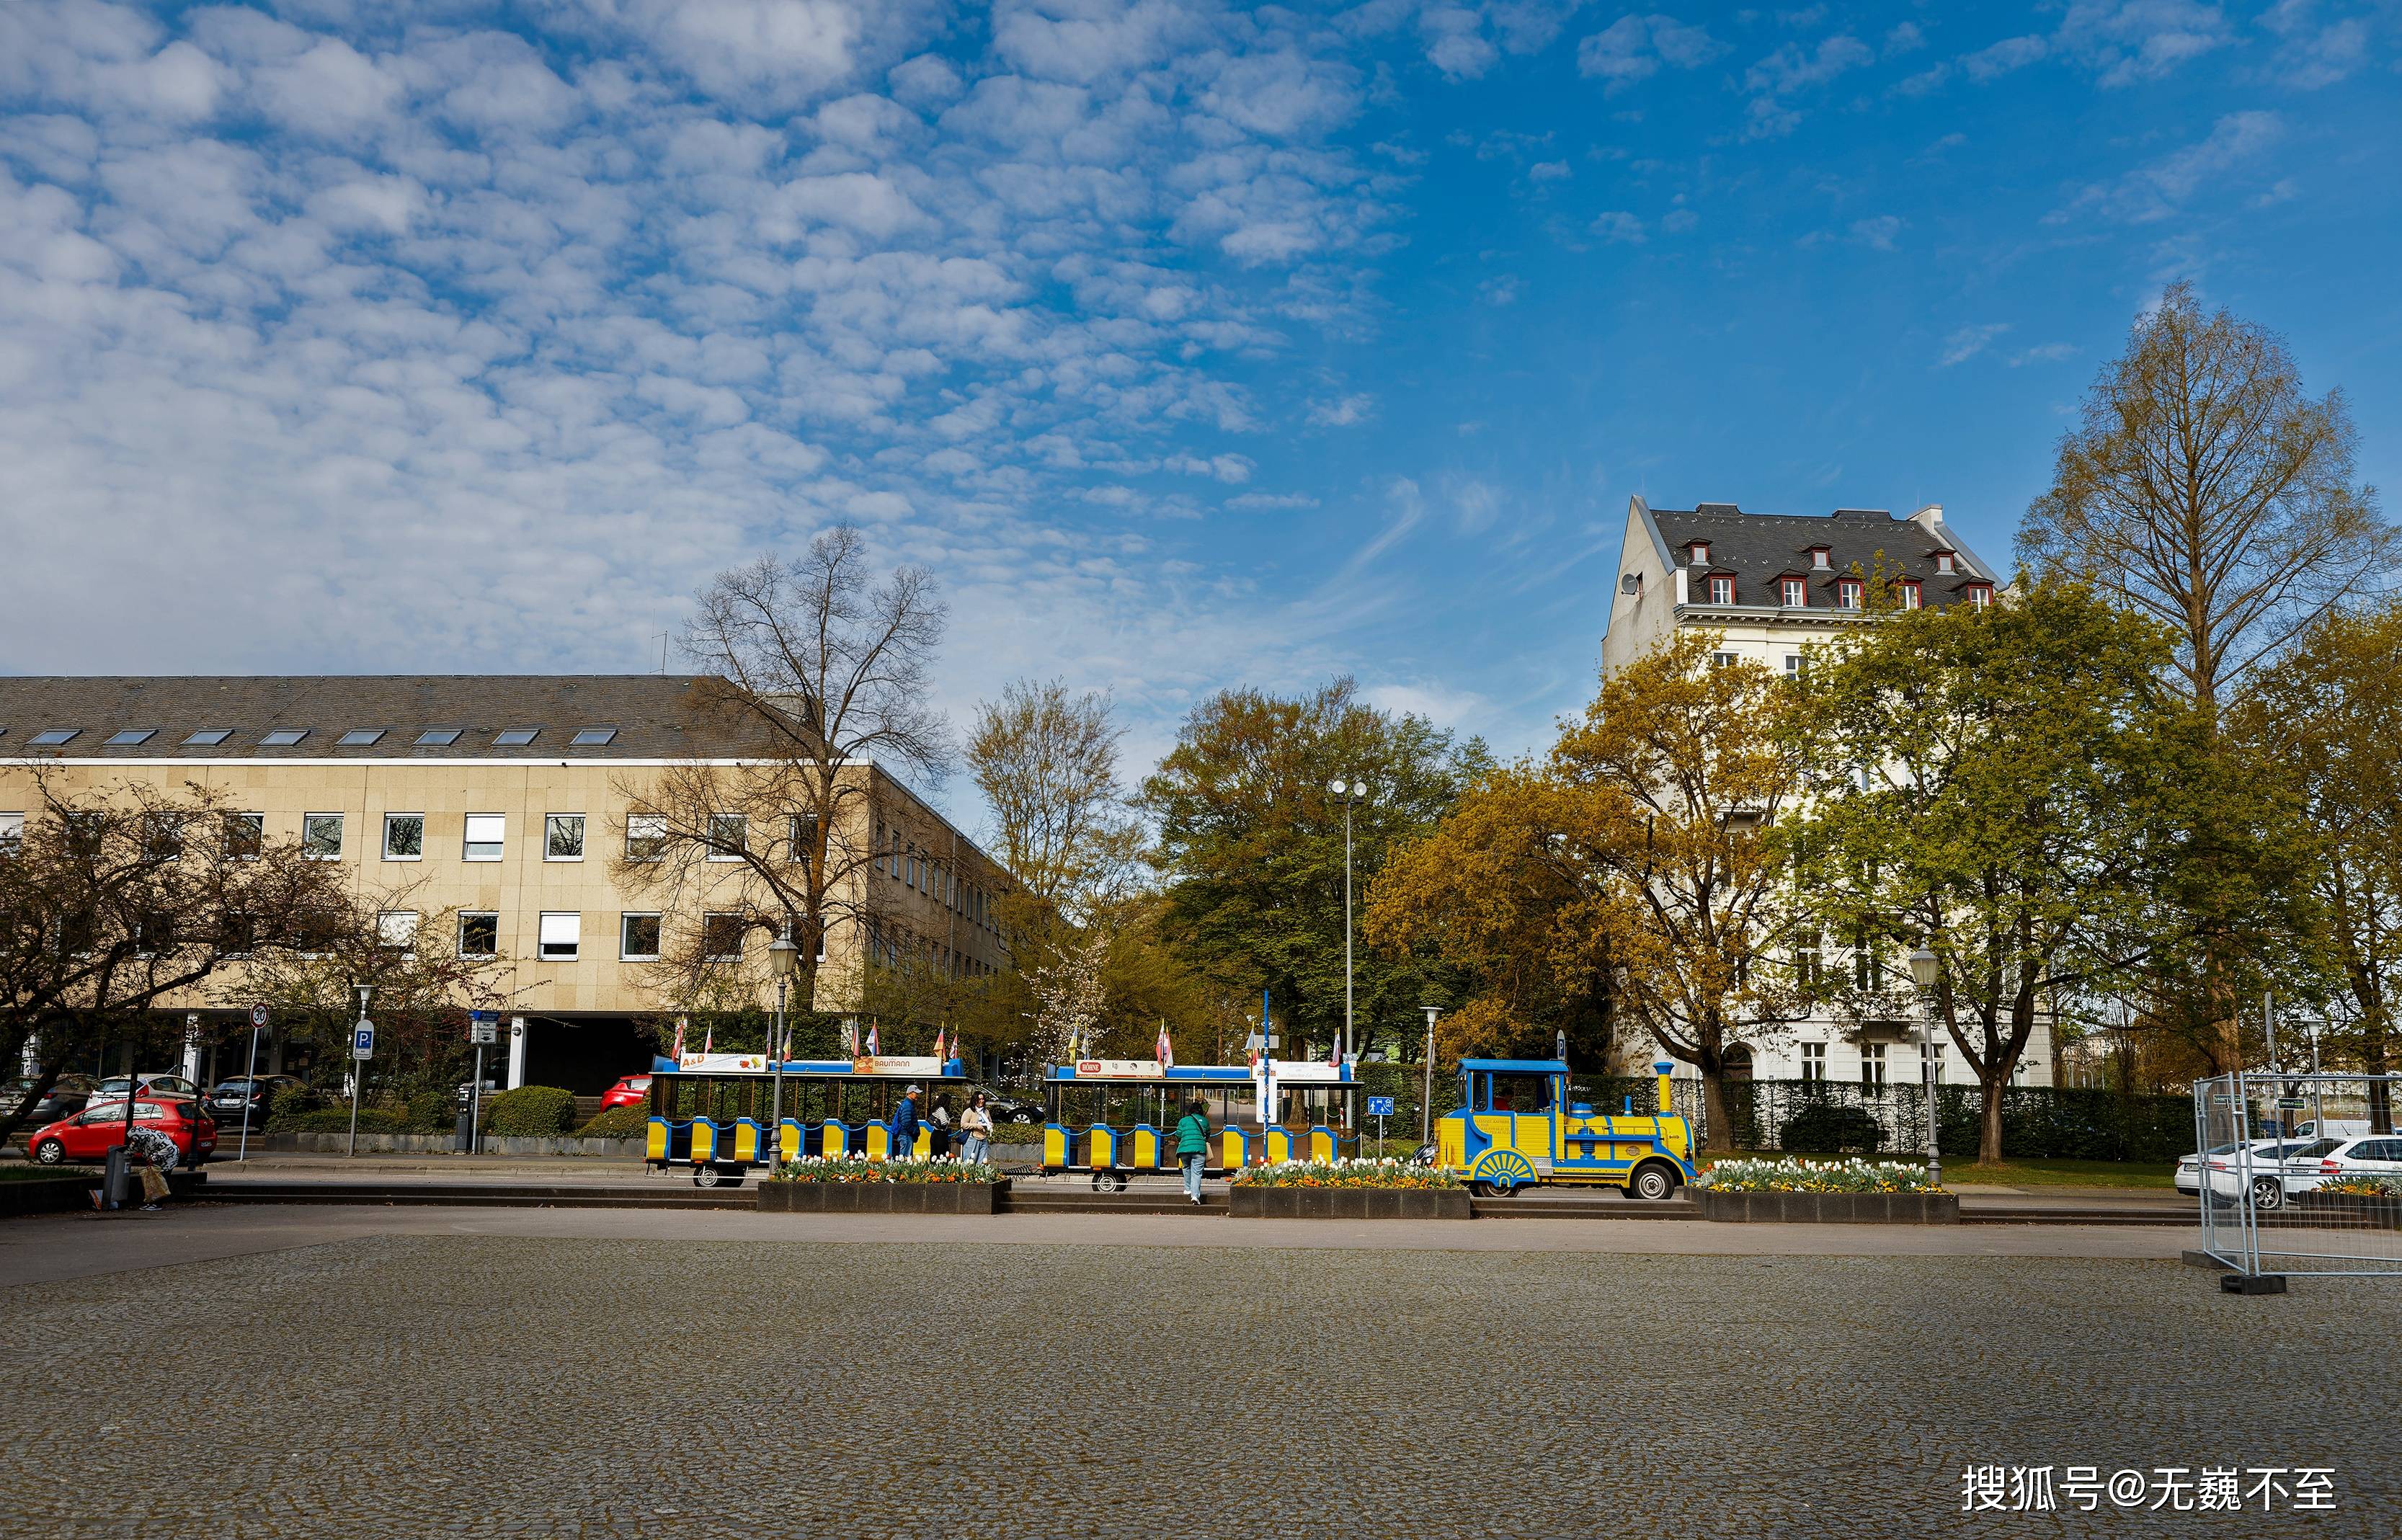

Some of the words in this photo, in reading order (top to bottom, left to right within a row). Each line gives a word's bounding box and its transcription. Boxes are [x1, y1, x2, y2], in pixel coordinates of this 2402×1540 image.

[254, 1009, 265, 1021] 30
[360, 1033, 368, 1046] P
[1559, 1041, 1564, 1054] P
[1082, 1063, 1100, 1072] HÖHNE
